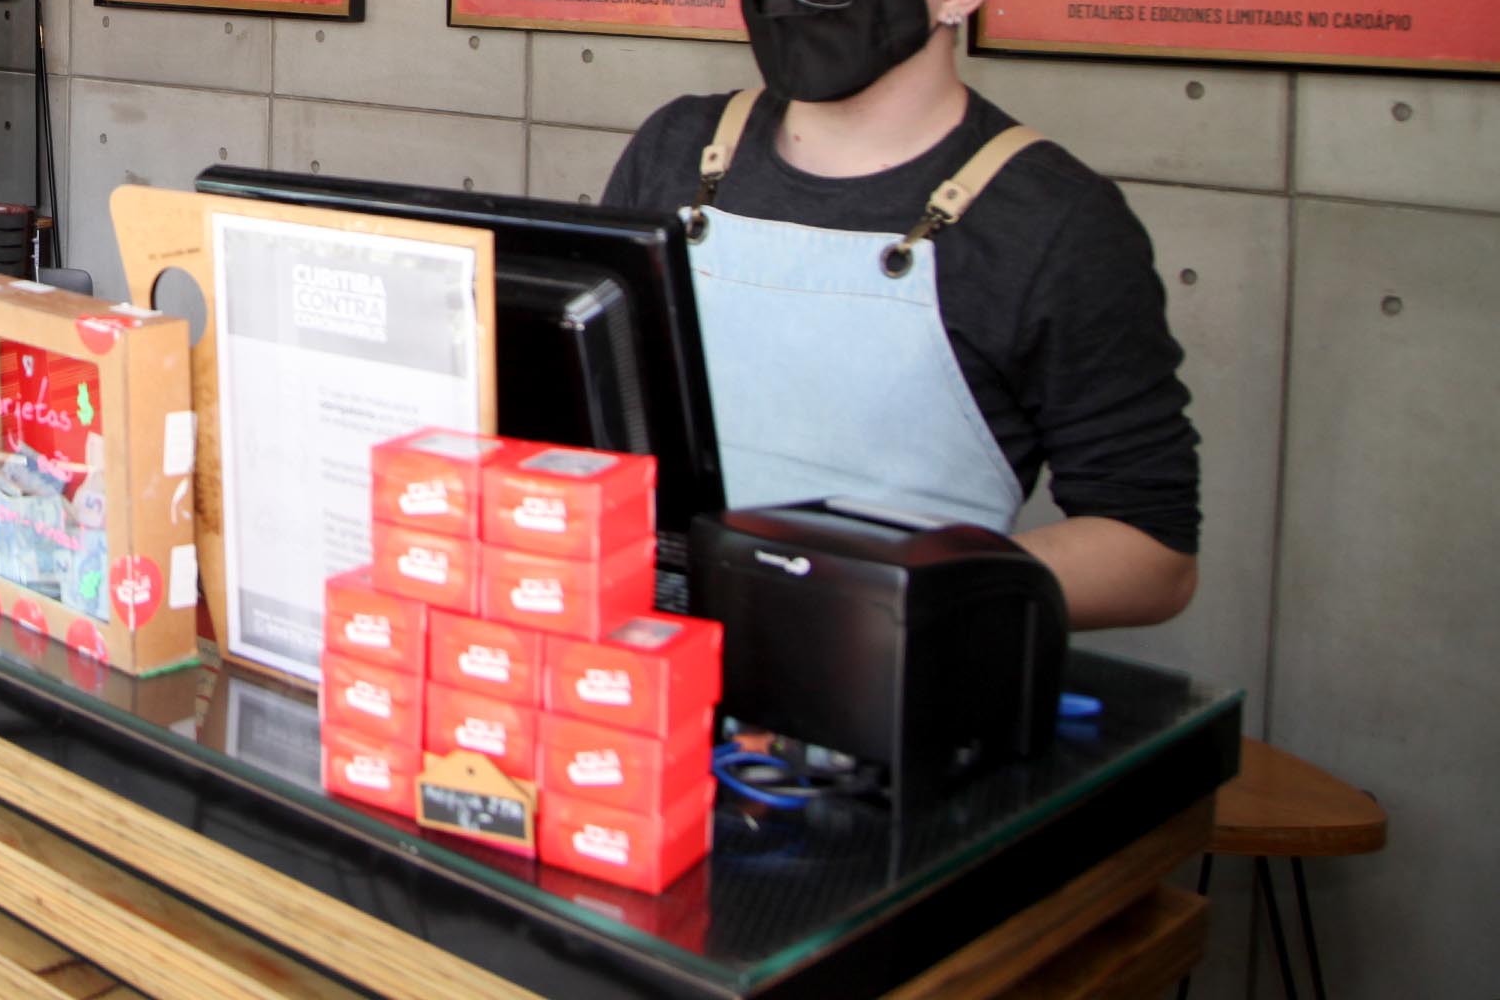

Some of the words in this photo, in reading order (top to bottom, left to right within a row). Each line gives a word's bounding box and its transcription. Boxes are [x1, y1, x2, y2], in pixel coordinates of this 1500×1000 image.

[1067, 4, 1135, 22] DETALHES
[1139, 5, 1147, 22] E
[1150, 6, 1222, 25] EDIZIONES
[1226, 8, 1304, 28] LIMITADAS
[1307, 10, 1328, 29] NO
[1333, 8, 1412, 32] CARDÁPIO
